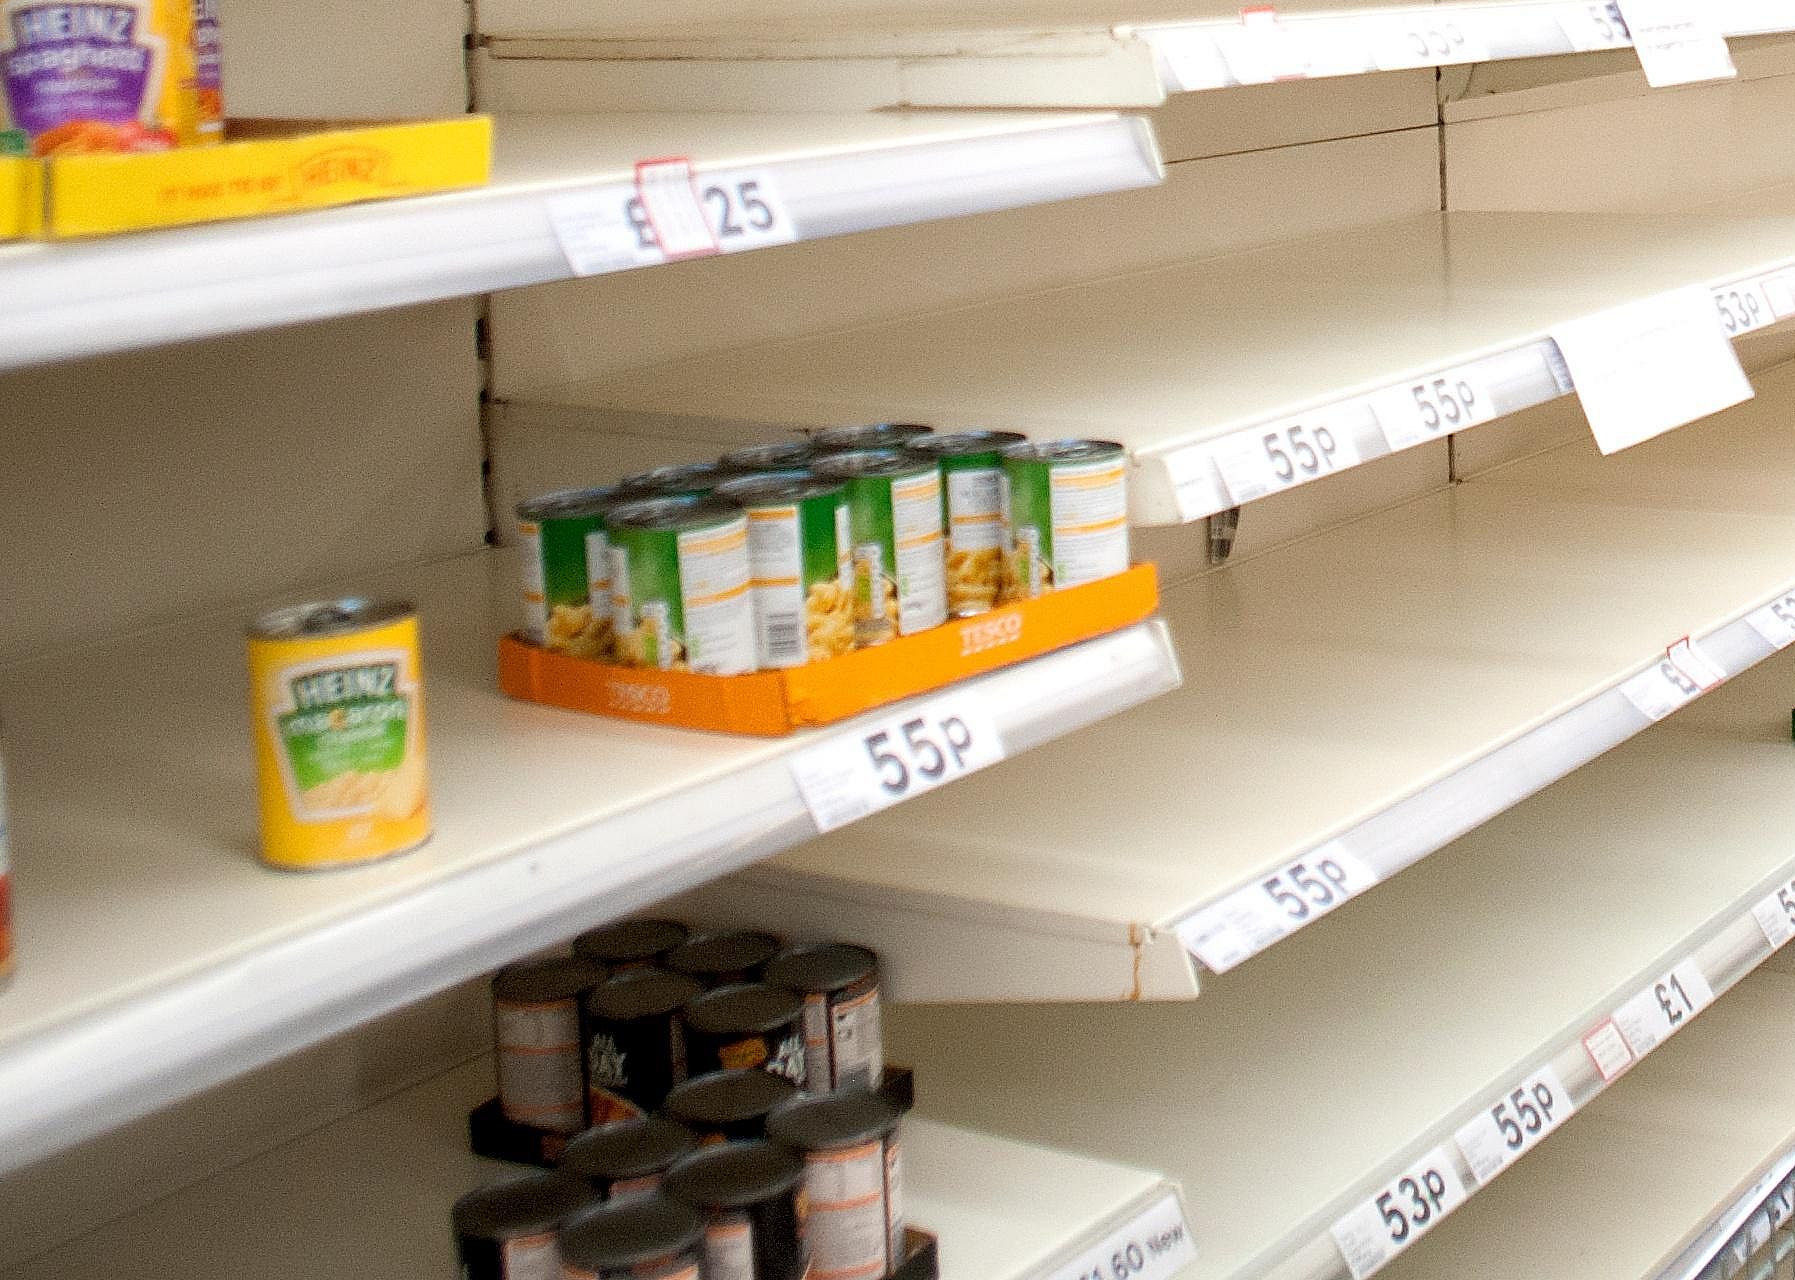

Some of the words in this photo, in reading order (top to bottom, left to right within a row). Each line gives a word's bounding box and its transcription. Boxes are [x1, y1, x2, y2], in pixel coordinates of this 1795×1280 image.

[20, 5, 135, 43] HEINZ
[1714, 290, 1760, 333] 53p
[1412, 378, 1475, 431] 55p
[1262, 425, 1337, 483] 55p
[961, 613, 1022, 646] TESCO
[296, 664, 396, 706] HEINZ
[864, 716, 972, 796] 55p
[1262, 859, 1347, 920] 55p
[1654, 972, 1695, 1026] £1
[1490, 1080, 1554, 1151] 55p
[1375, 1169, 1447, 1243] 53p
